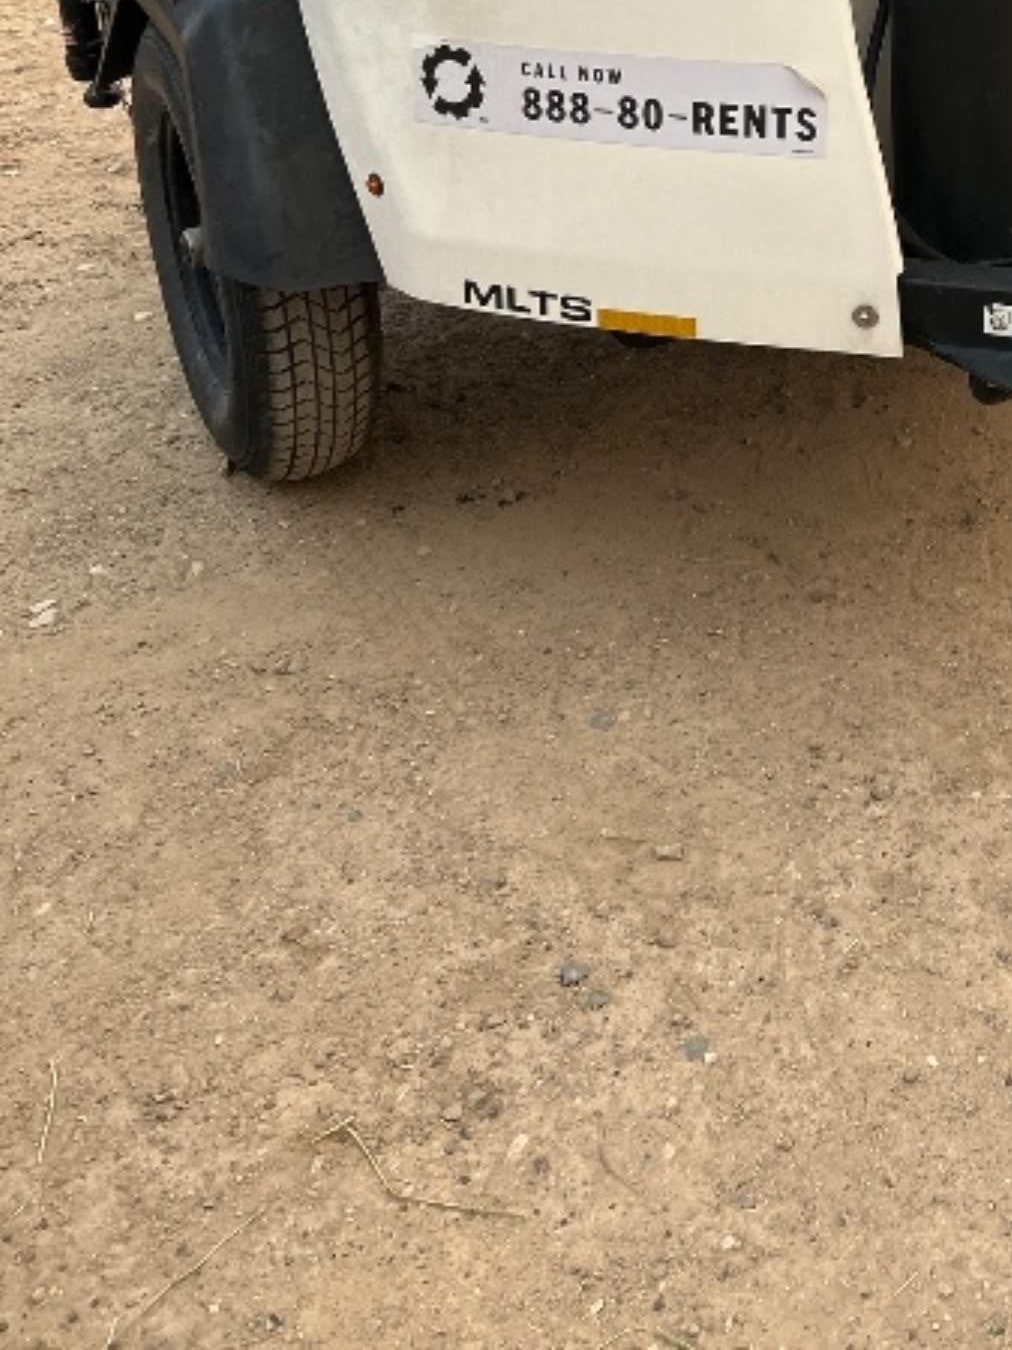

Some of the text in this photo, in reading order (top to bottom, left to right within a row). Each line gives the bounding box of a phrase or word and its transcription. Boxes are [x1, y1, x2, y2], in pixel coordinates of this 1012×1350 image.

[520, 61, 623, 85] CALL NOW
[521, 87, 818, 142] 888-80-RENTS
[463, 279, 593, 321] MLTS
